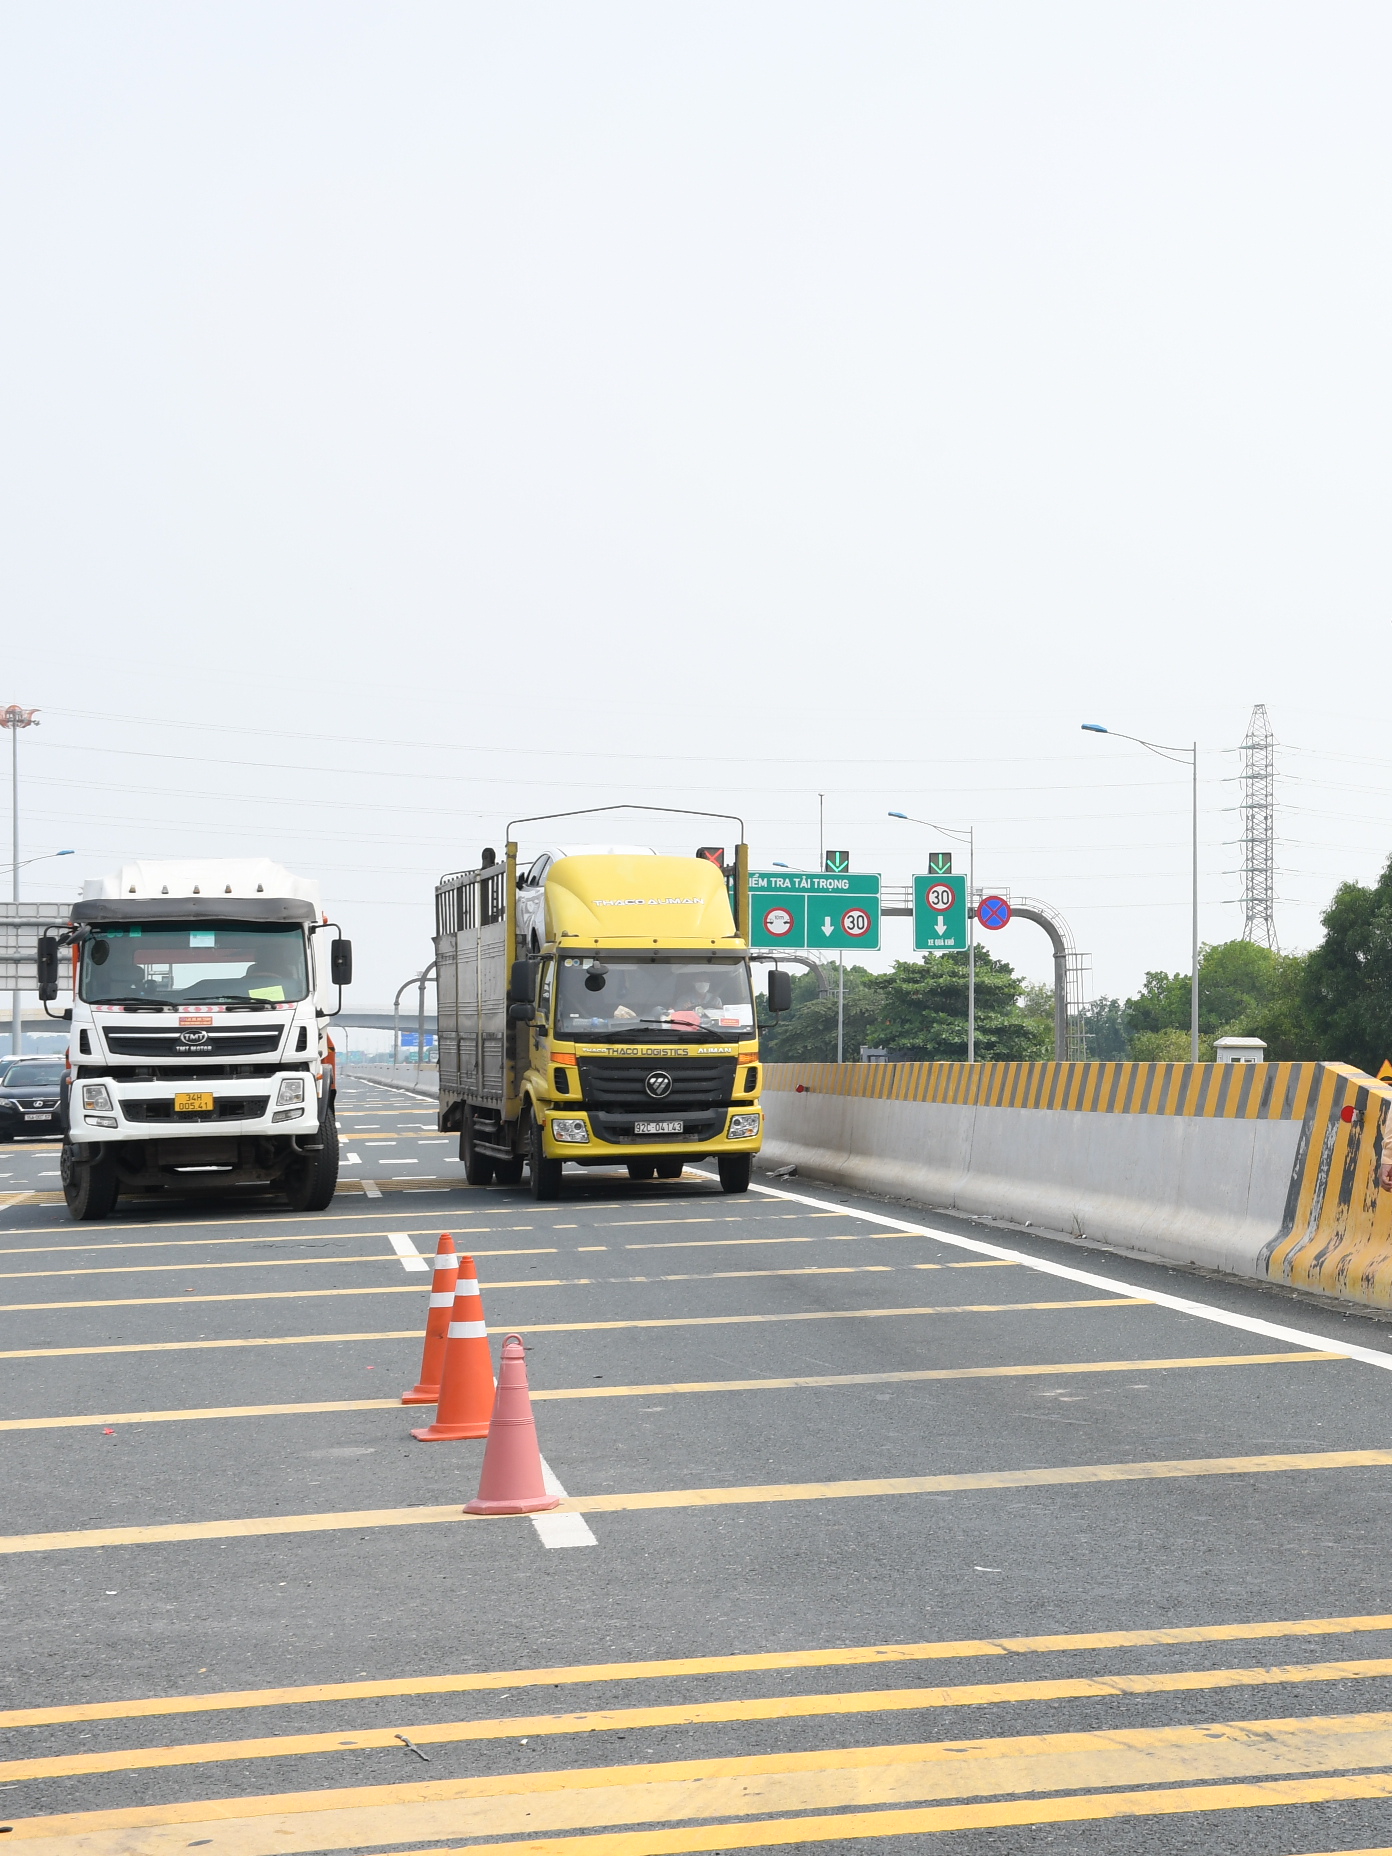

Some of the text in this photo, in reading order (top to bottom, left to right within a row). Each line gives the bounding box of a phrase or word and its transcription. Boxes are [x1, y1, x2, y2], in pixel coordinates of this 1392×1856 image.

[748, 873, 768, 888] IỂM
[770, 877, 792, 889] TRA
[793, 875, 811, 889] TẢI
[813, 878, 849, 891] TRỌNG
[592, 897, 705, 907] THACO AUMAN
[931, 889, 950, 906] 30
[846, 914, 865, 931] 30
[606, 1047, 689, 1056] THACO LOGISTICS
